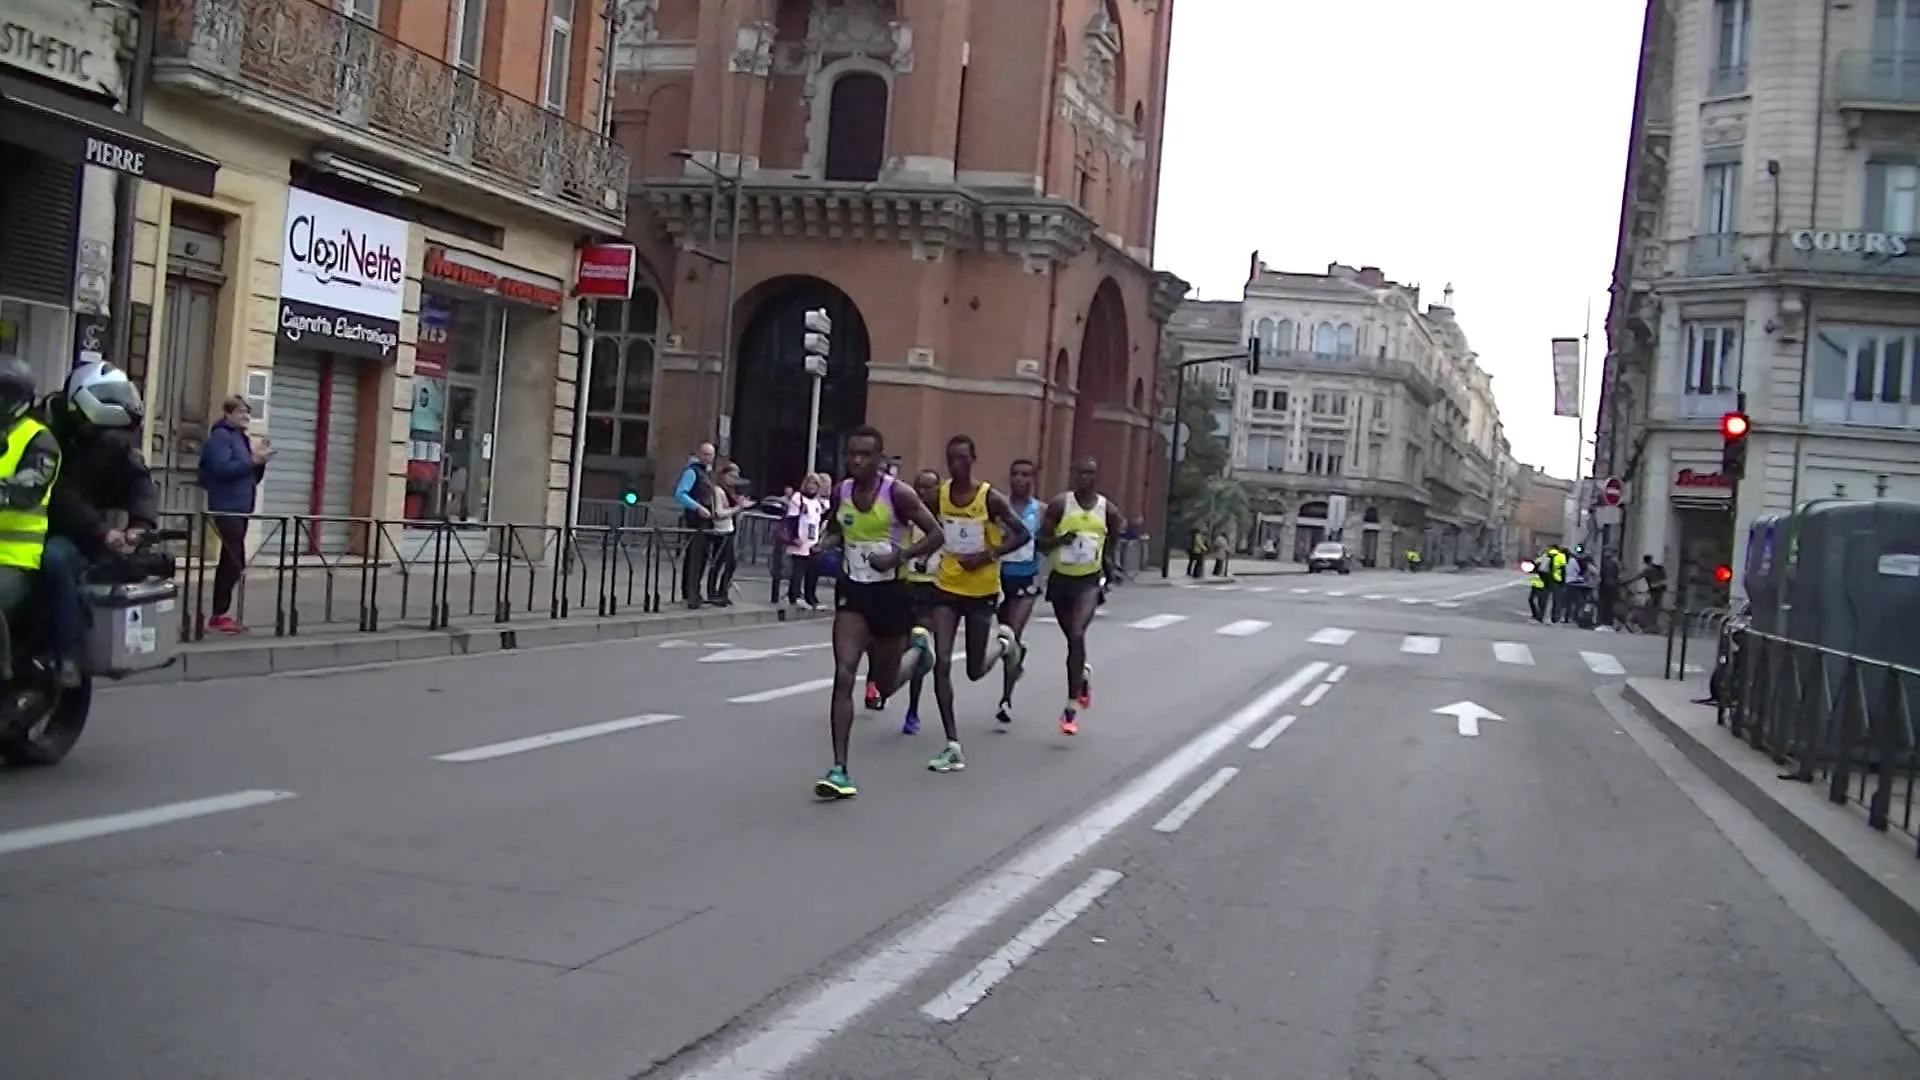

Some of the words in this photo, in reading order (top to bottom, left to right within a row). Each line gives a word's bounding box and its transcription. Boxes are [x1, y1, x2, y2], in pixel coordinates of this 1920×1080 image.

[86, 137, 145, 176] PIERRE
[1792, 229, 1907, 254] COURS
[959, 527, 968, 540] 6
